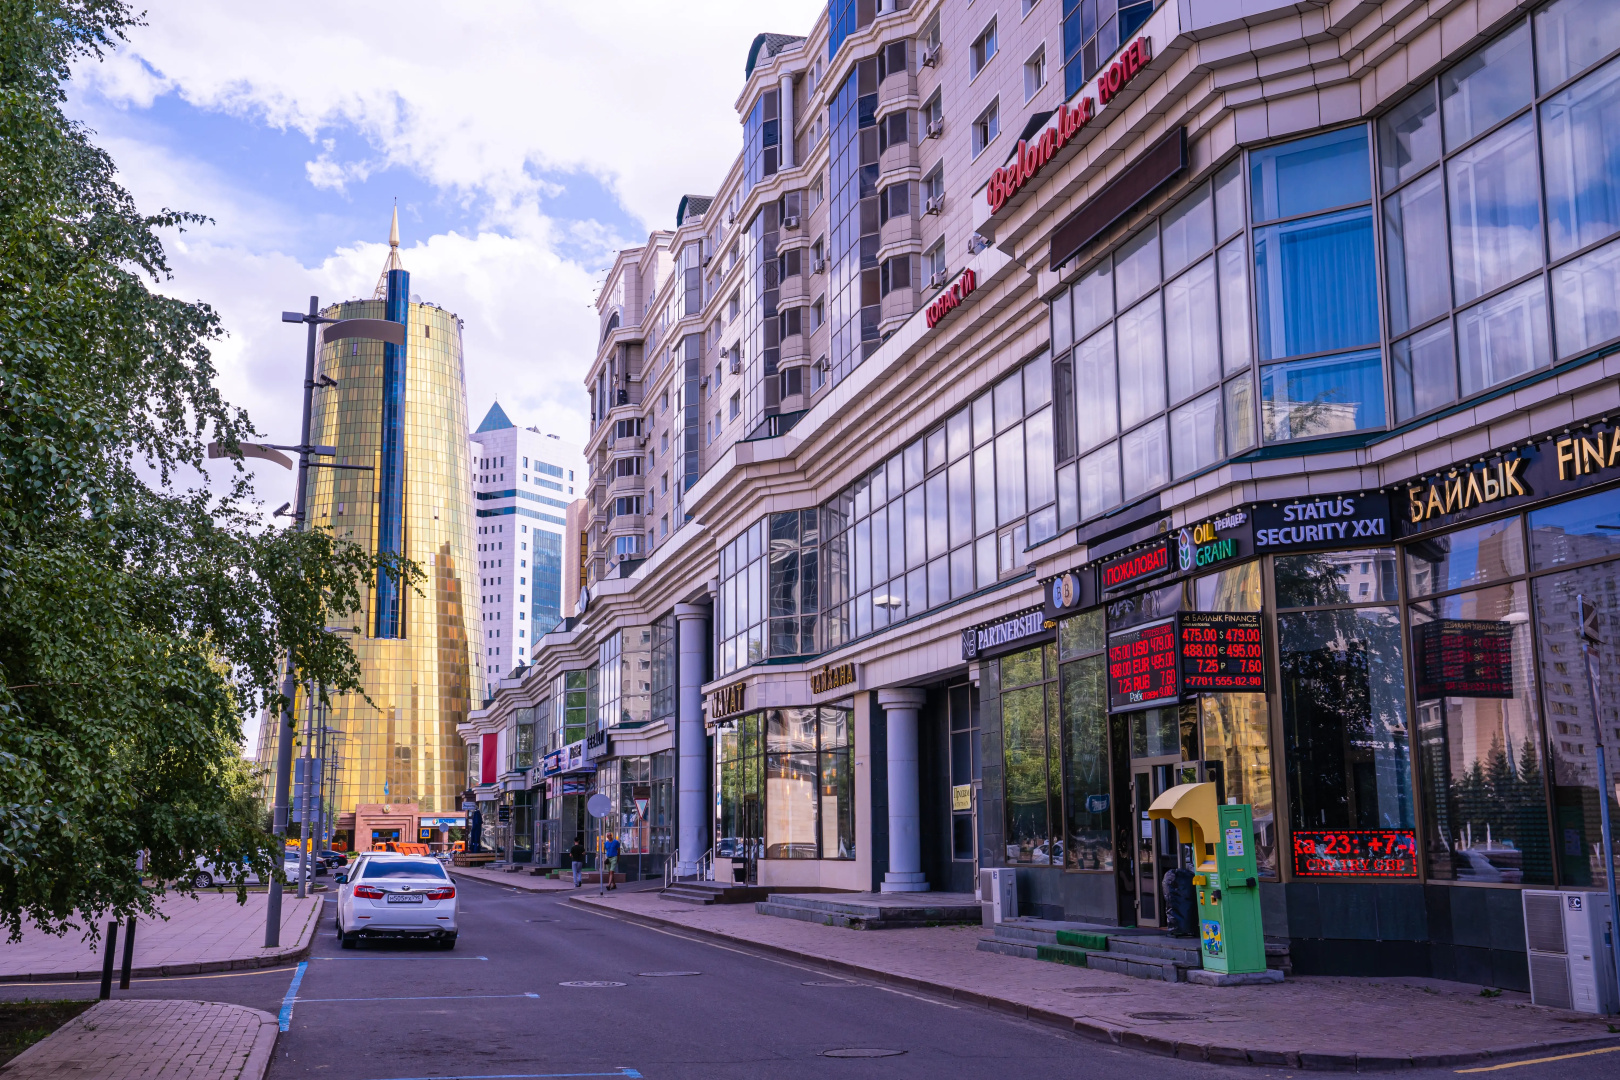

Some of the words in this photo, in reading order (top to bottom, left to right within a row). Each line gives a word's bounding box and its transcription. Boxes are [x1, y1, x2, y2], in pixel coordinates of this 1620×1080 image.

[1098, 37, 1150, 105] HOTEL
[1284, 499, 1355, 522] STATUS
[1193, 523, 1217, 544] OIL
[1256, 522, 1350, 546] SECURITY
[1352, 518, 1385, 538] XXI
[1196, 538, 1235, 566] GRAIN
[1224, 614, 1257, 623] FINANCE
[978, 610, 1044, 650] PARTNERSHIP
[1182, 628, 1217, 642] 475.00
[1225, 628, 1260, 642] 479.00
[1109, 644, 1131, 662] 475.00
[1132, 640, 1148, 657] USD
[1150, 633, 1175, 652] 479.00
[1183, 644, 1218, 658] 488.00
[1226, 644, 1261, 657] 495.00
[1133, 657, 1149, 674] EUR
[1151, 651, 1175, 669] 495.00
[1197, 659, 1219, 673] 7.25
[1239, 660, 1262, 673] 7.60
[1134, 674, 1150, 691] RUB
[1185, 677, 1213, 686] +7701
[1215, 676, 1261, 686] 555-02-90
[1323, 834, 1359, 854] 23:
[1306, 858, 1336, 871] CNY
[1338, 858, 1369, 871] TRY
[1373, 858, 1405, 871] GBP
